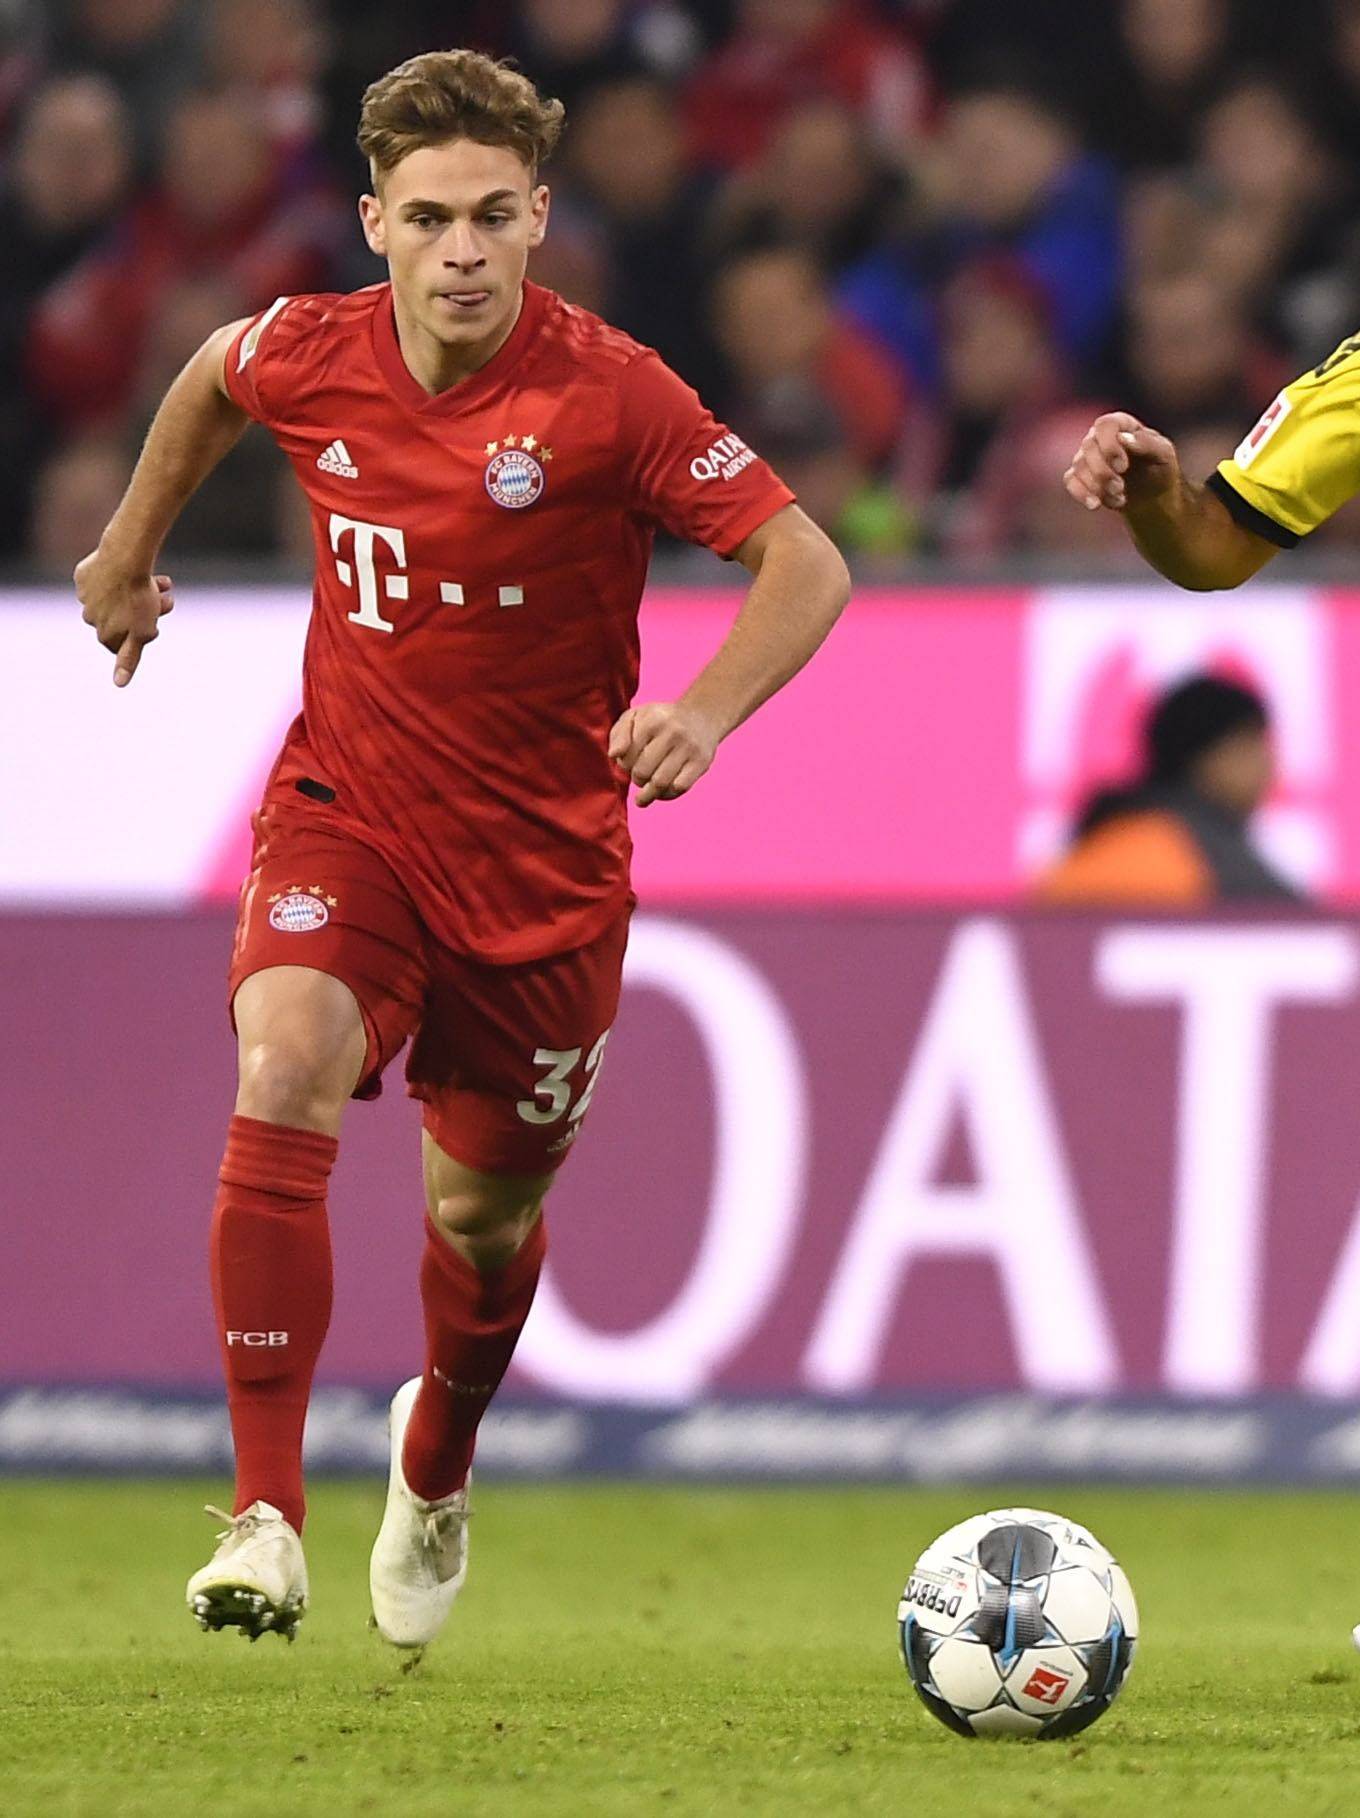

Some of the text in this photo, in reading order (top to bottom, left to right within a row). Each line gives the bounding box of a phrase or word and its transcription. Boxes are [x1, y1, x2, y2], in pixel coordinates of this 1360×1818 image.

[491, 454, 539, 479] FC BAYERN
[690, 433, 746, 480] QATA
[516, 1028, 610, 1124] 32
[226, 1330, 289, 1347] FCB
